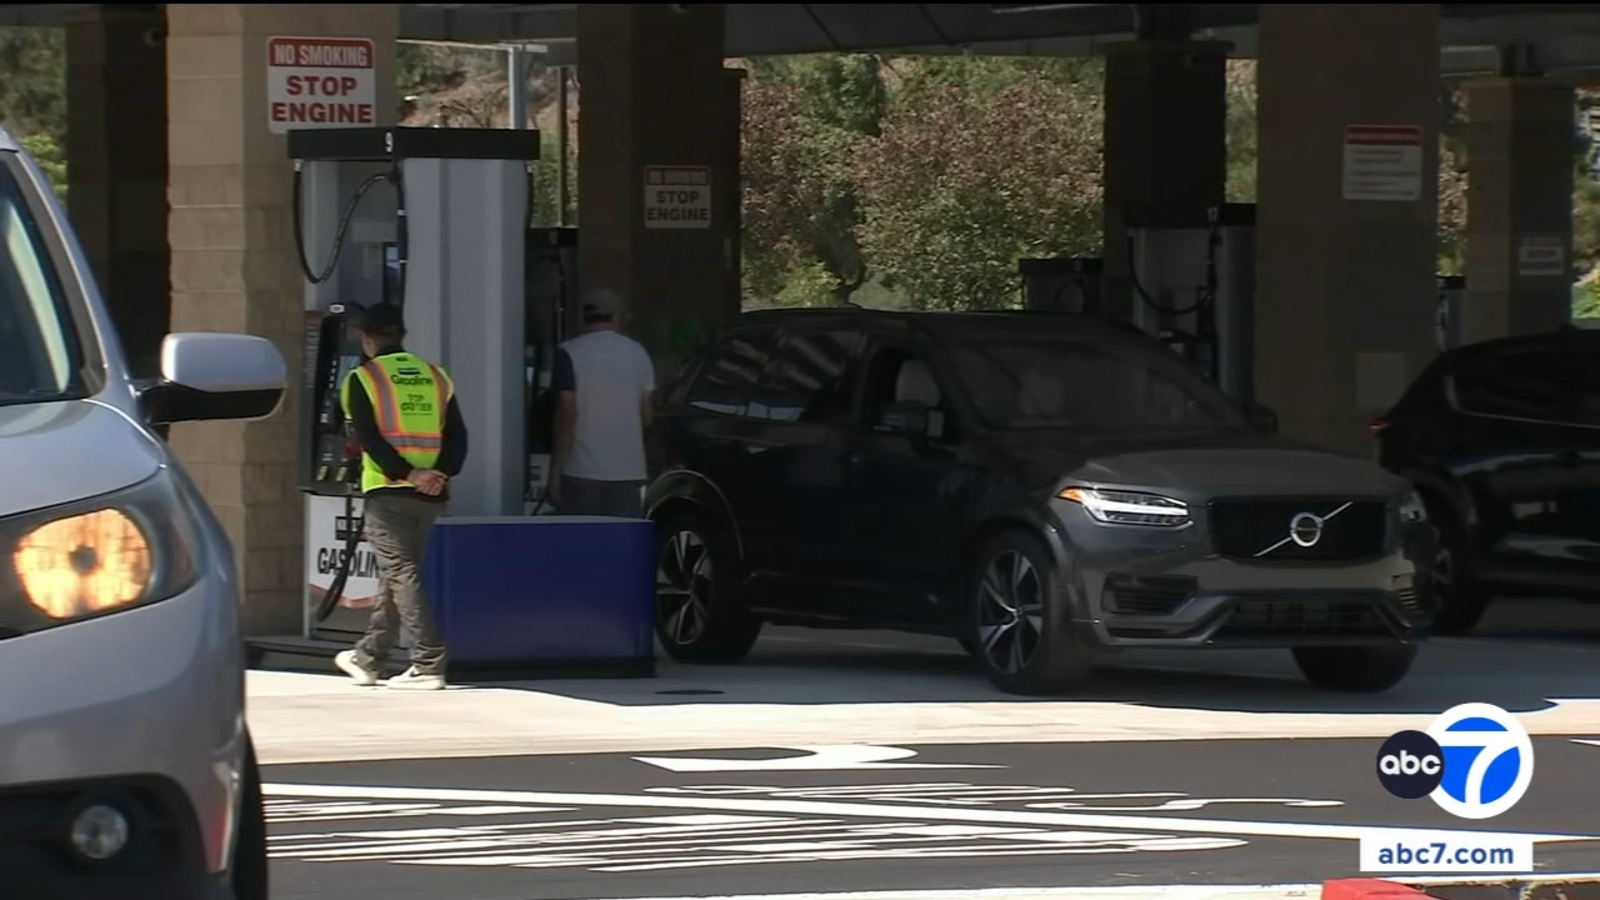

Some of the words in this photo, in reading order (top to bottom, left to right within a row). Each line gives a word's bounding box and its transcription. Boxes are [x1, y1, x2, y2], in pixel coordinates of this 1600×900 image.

[274, 44, 294, 65] NO
[300, 44, 368, 67] SMOKING
[286, 75, 358, 96] STOP
[271, 102, 373, 123] ENGINE
[385, 131, 393, 152] 9
[657, 191, 699, 204] STOP
[647, 208, 708, 221] ENGINE
[318, 547, 380, 578] GASOLIN
